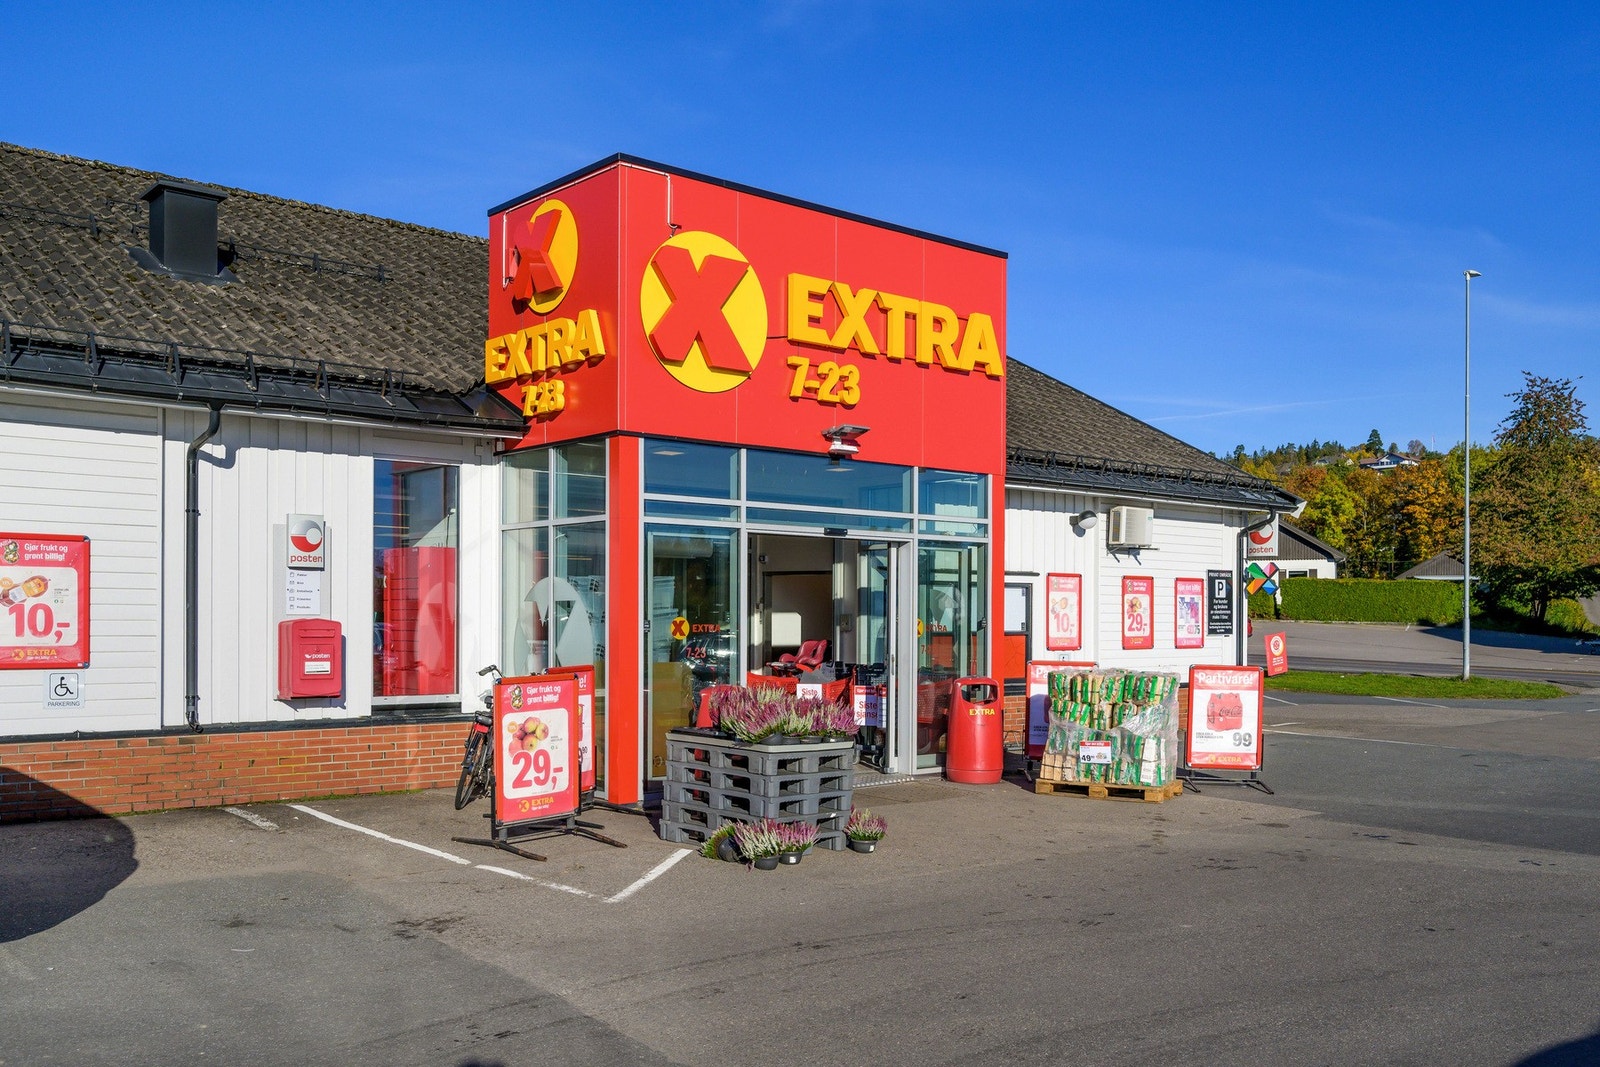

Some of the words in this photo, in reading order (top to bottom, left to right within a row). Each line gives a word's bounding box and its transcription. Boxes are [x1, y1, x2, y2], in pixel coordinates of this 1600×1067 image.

[787, 272, 1005, 377] EXTRA
[485, 308, 606, 384] EXTRA
[787, 355, 861, 405] 7-23
[521, 379, 566, 417] 7-23
[24, 543, 39, 552] Gjør
[1248, 546, 1274, 554] posten
[44, 553, 65, 562] billig!
[290, 554, 322, 564] posten
[1218, 582, 1224, 596] P
[8, 603, 70, 644] 10,-
[692, 624, 721, 632] EXTRA
[1128, 613, 1148, 634] 29,-
[686, 647, 706, 658] 7-23
[1198, 672, 1253, 685] Partivare!
[526, 686, 538, 695] Gjør
[859, 701, 877, 709] Siste
[1232, 732, 1252, 747] 99
[512, 749, 563, 790] 29,-
[532, 797, 554, 806] EXTRA
